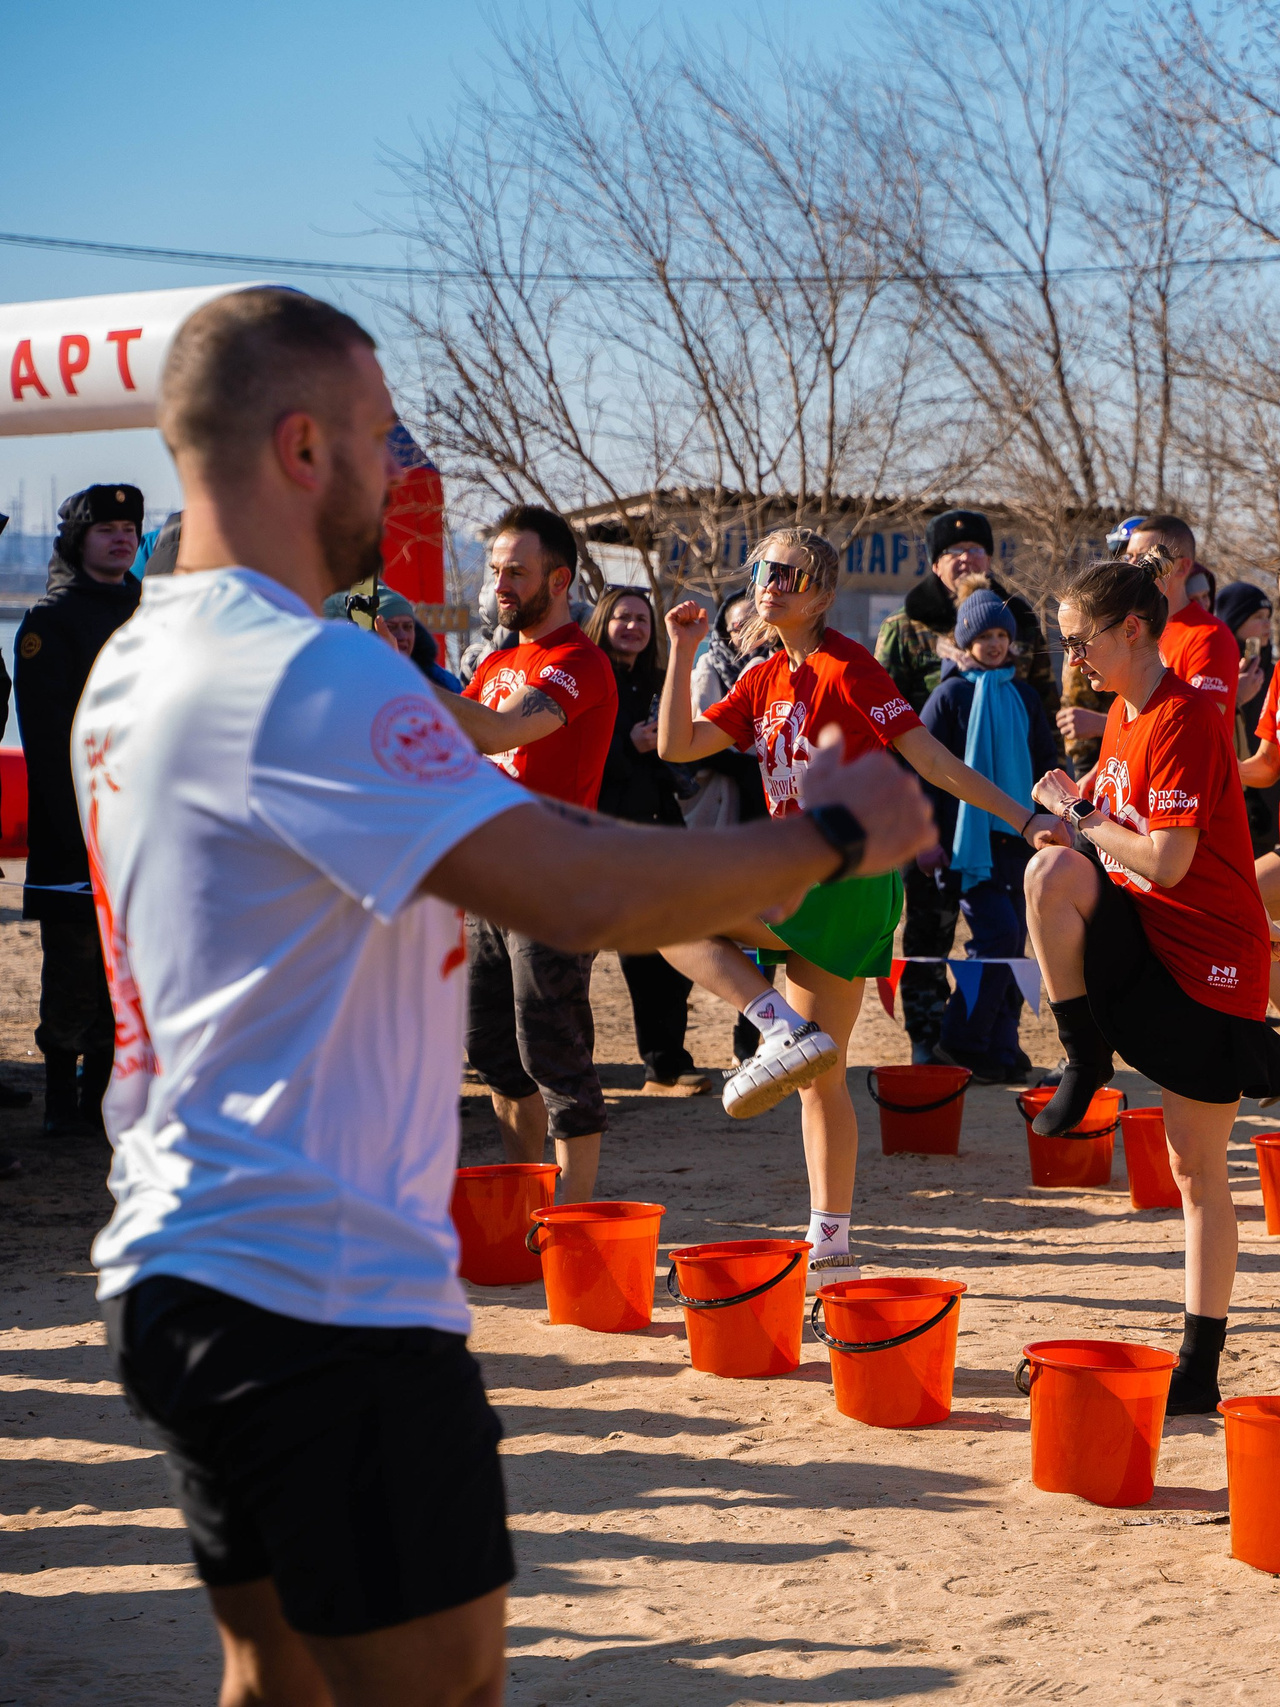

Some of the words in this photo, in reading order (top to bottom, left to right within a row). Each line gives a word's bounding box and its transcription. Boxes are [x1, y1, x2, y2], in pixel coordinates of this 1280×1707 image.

[11, 328, 142, 400] АРТ
[553, 669, 576, 686] ПУТЬ
[549, 674, 579, 699] ДОМОЙ
[1158, 789, 1187, 800] ПУТЬ
[1157, 796, 1198, 810] ДОМОЙ
[1211, 965, 1237, 977] N1
[1207, 975, 1240, 985] SPORT
